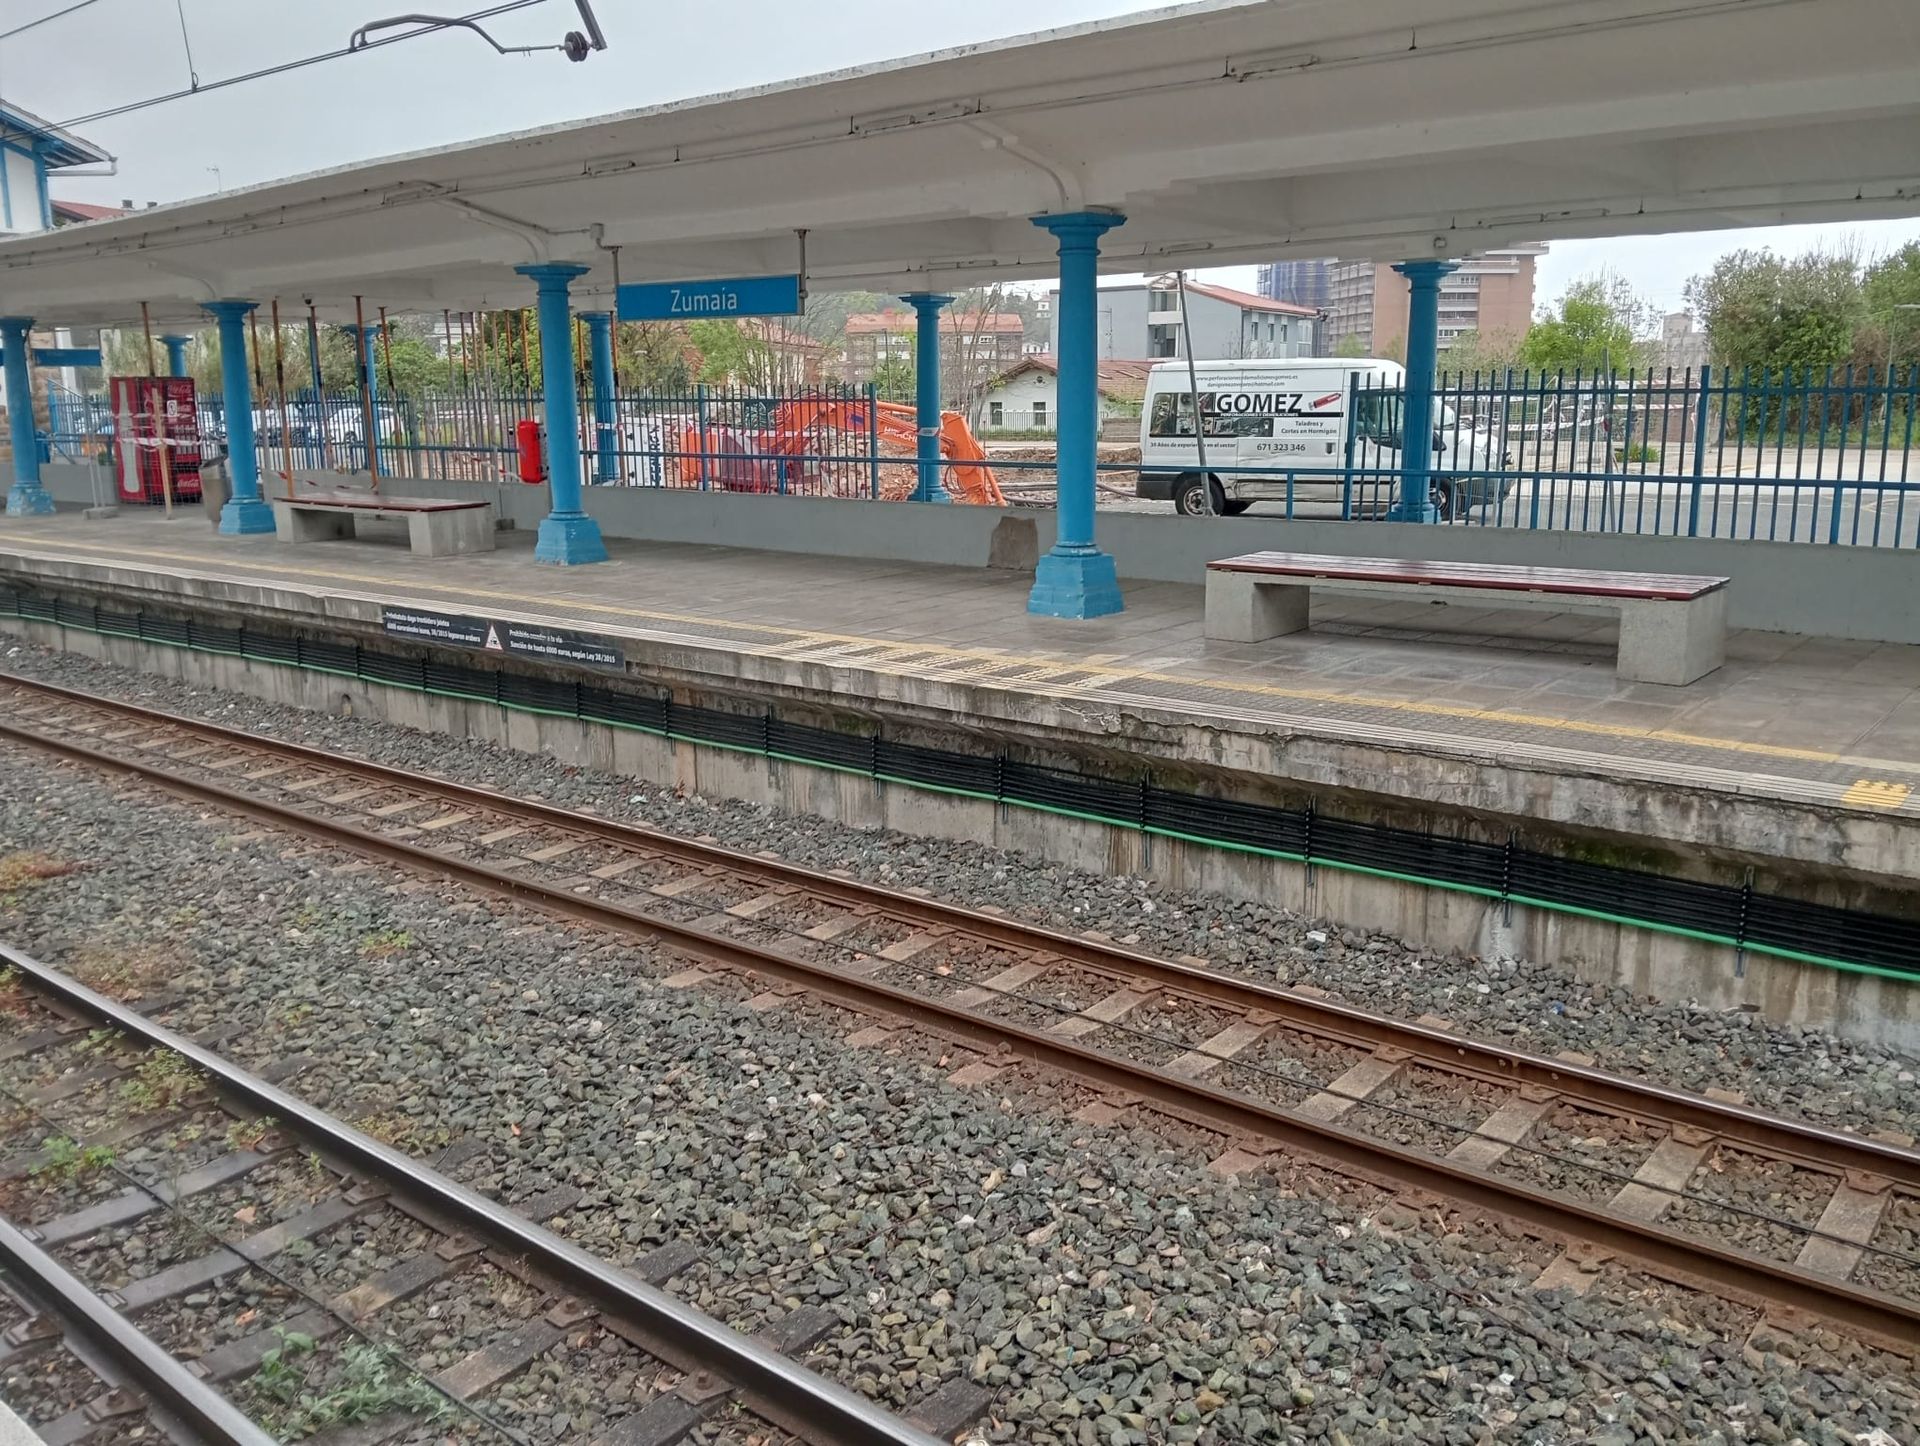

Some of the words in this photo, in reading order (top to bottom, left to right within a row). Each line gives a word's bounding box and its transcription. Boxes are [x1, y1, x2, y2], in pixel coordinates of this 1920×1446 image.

[670, 287, 737, 312] Zumaia
[1216, 393, 1303, 413] GOMEZ
[1257, 443, 1272, 451] 671
[1273, 443, 1289, 451] 323
